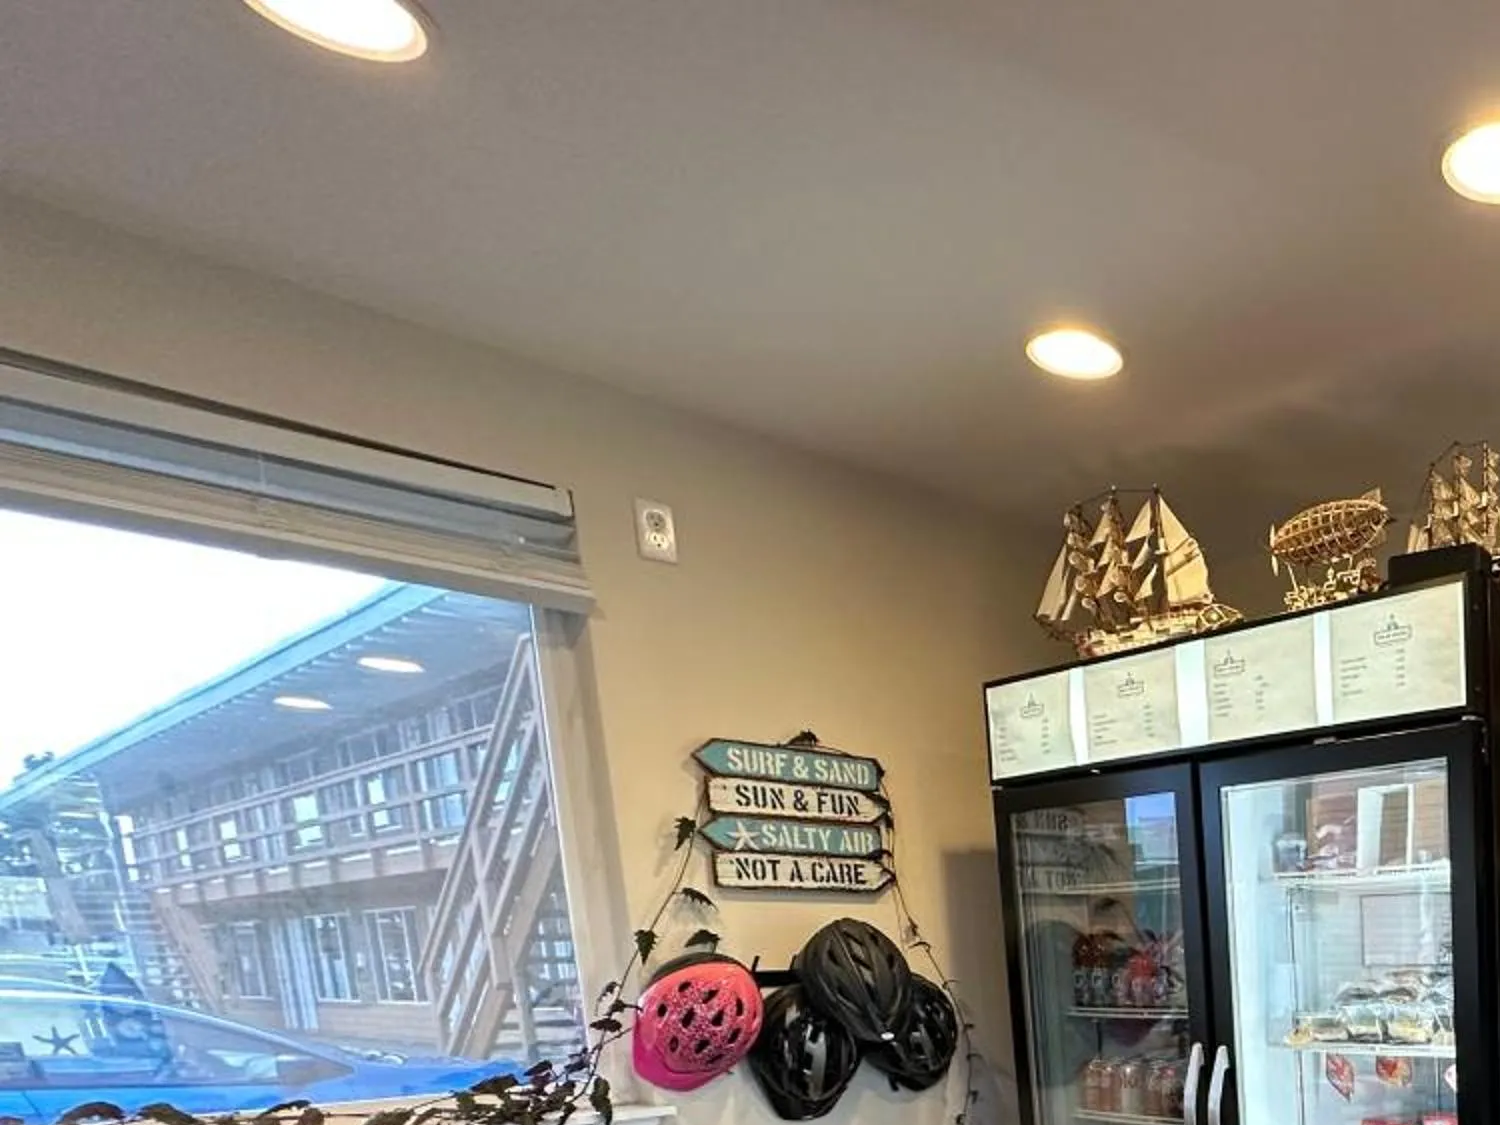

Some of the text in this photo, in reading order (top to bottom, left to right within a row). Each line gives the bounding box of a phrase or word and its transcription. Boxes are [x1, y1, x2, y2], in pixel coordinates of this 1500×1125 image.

[726, 746, 870, 785] SURF & SAND
[735, 785, 859, 815] SUN & FUN
[761, 824, 874, 855] SALTY AIR
[735, 857, 867, 885] NOT A CARE
